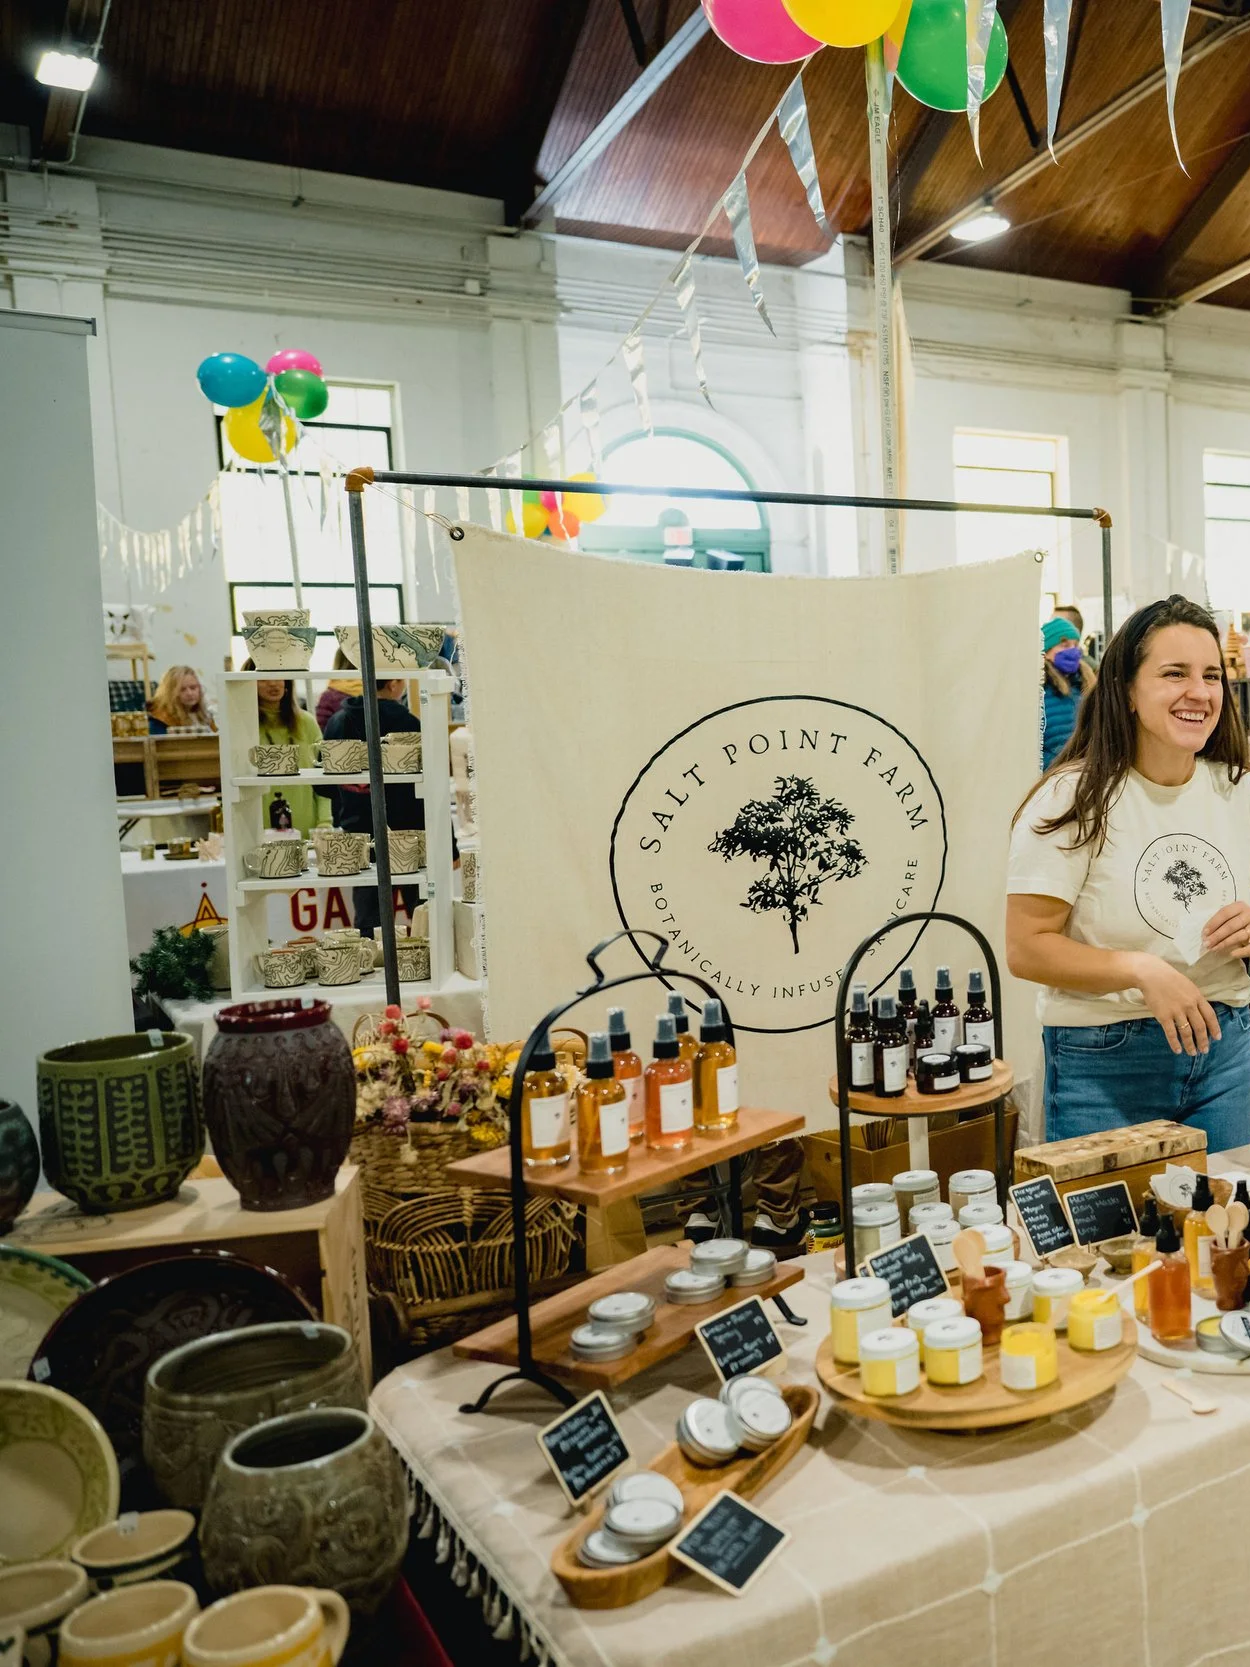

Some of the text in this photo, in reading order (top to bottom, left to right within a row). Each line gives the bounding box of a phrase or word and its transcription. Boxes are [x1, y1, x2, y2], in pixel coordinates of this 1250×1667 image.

[874, 116, 882, 145] EAGLE
[877, 206, 885, 233] SCH40
[639, 728, 929, 854] SALT POINT FARM
[1142, 844, 1229, 883] SALT OINT FARM
[649, 881, 762, 997] BOTANICALLY
[773, 967, 845, 999] INFUSE
